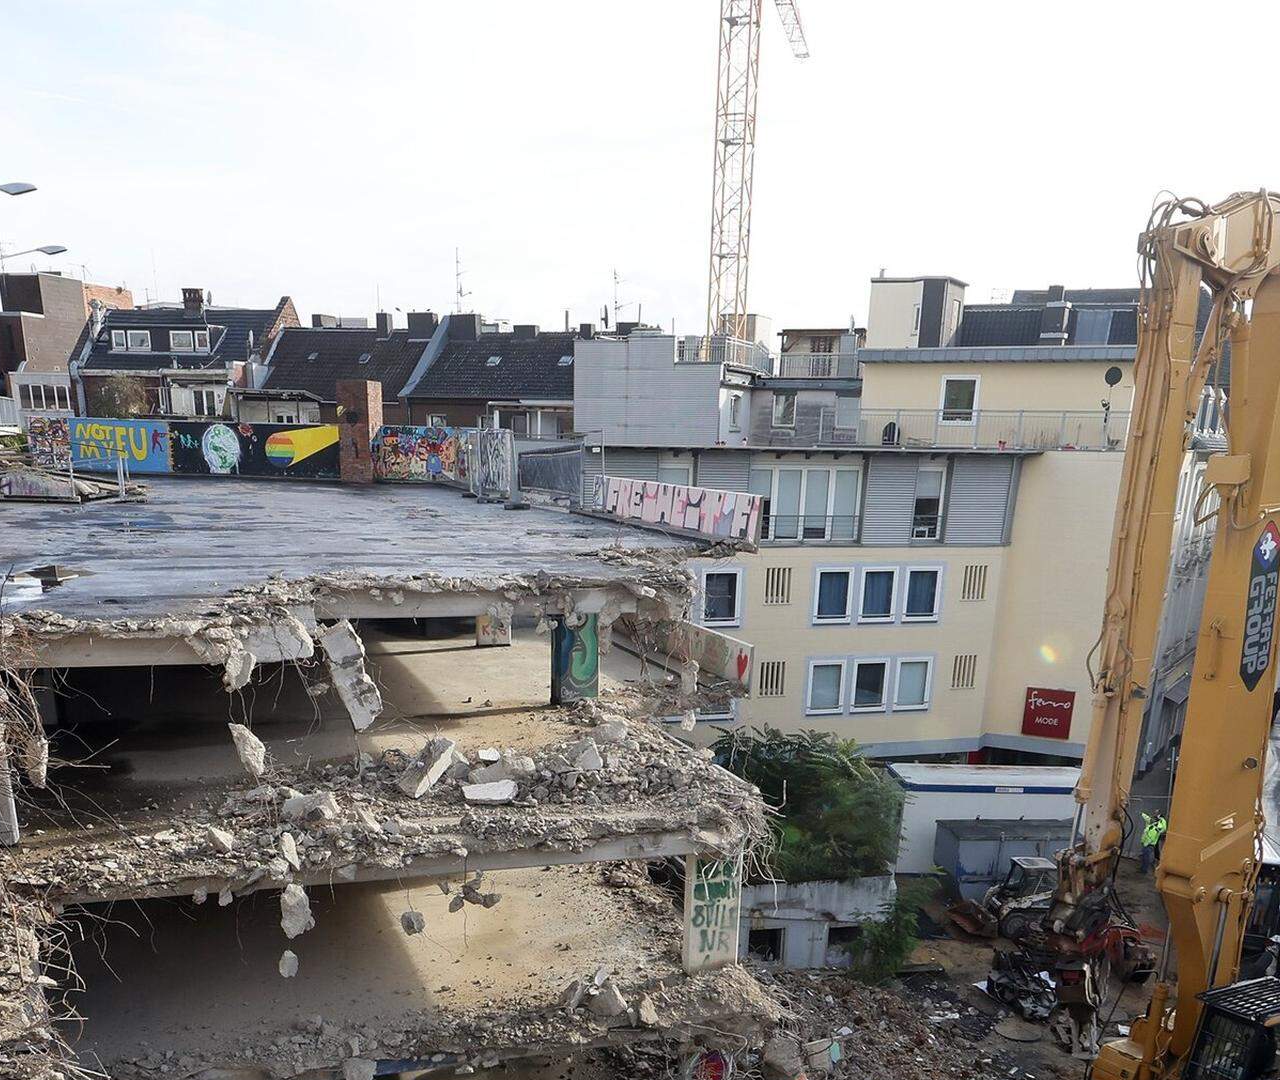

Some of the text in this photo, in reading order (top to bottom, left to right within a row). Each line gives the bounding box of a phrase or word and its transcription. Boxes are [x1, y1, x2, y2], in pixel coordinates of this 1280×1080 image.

[75, 423, 114, 440] NOT
[114, 426, 148, 461] EU
[79, 440, 114, 460] MY
[1241, 574, 1266, 674] GROUP
[1257, 571, 1278, 671] FERRARO
[1034, 716, 1059, 726] MODE
